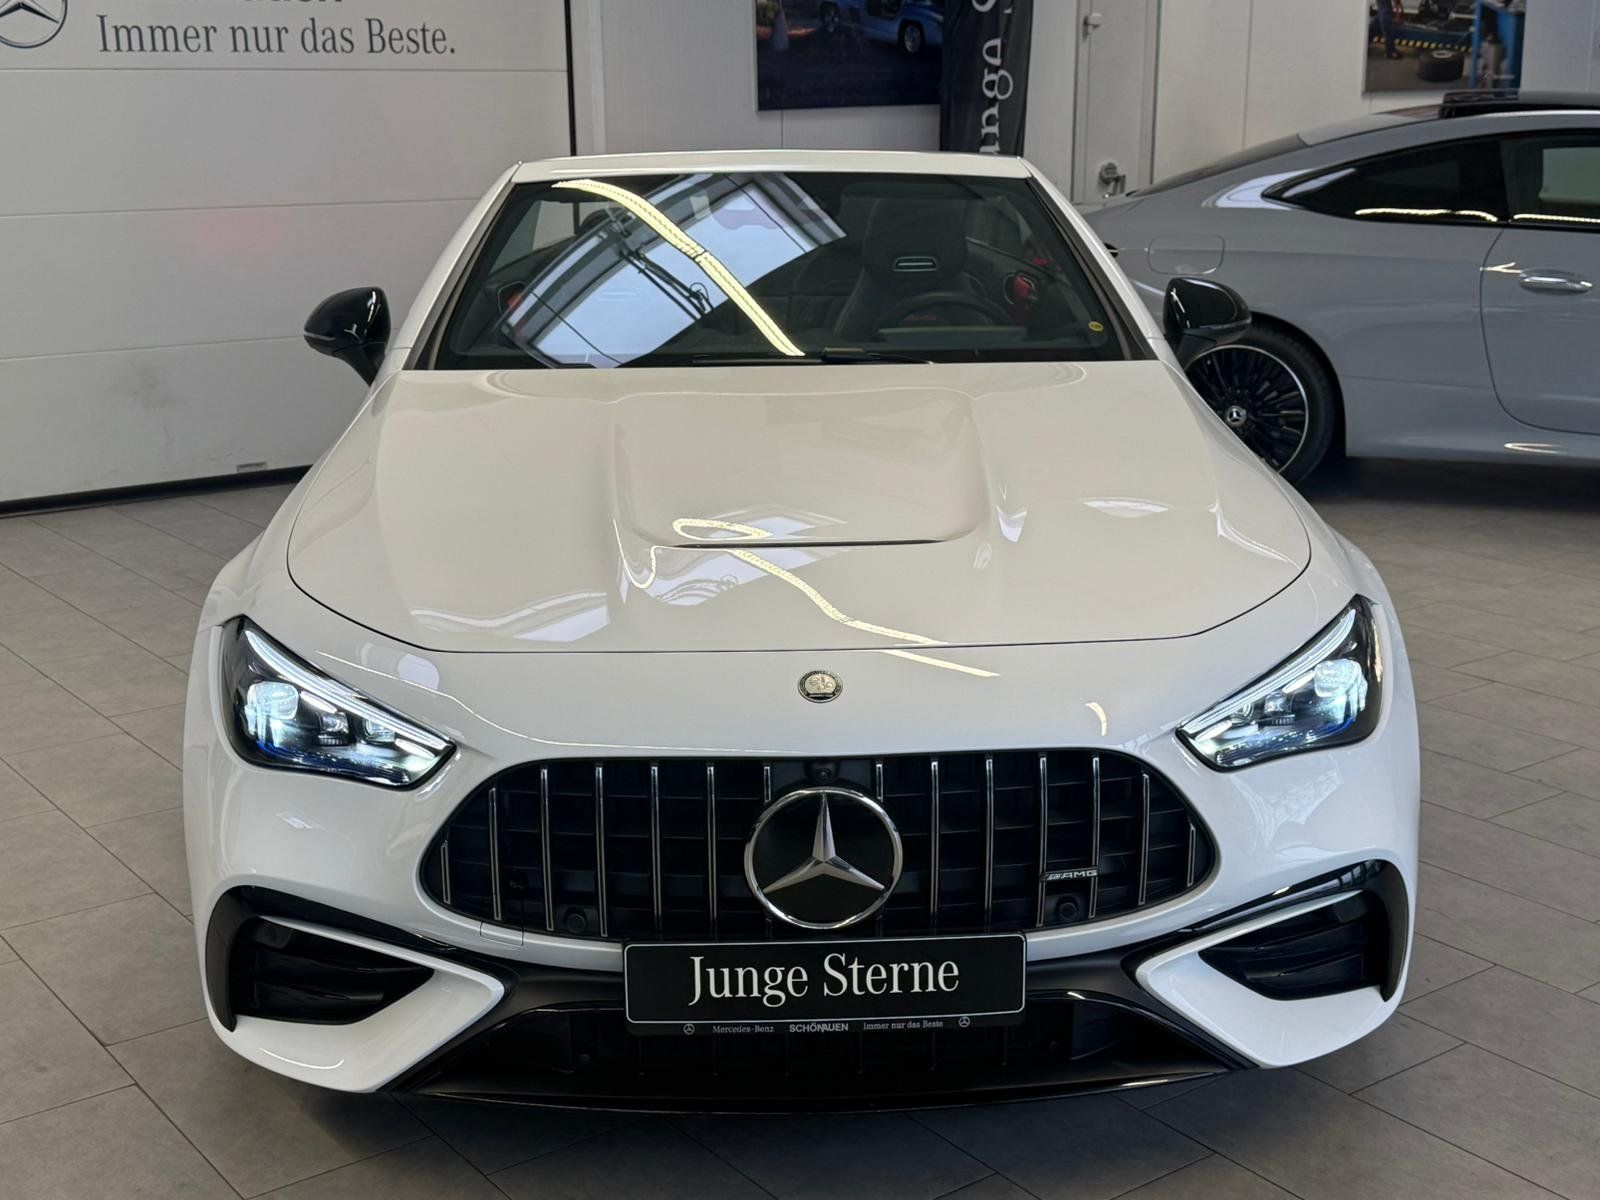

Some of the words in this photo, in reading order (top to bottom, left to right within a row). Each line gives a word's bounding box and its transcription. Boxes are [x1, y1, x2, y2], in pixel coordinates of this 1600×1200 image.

[96, 13, 218, 53] Immer
[228, 24, 289, 53] nur
[300, 17, 355, 54] das
[364, 17, 455, 54] Beste.
[1059, 868, 1099, 880] AMG
[688, 956, 809, 1008] Junge
[823, 953, 960, 997] Sterne
[863, 1022, 890, 1031] Immer
